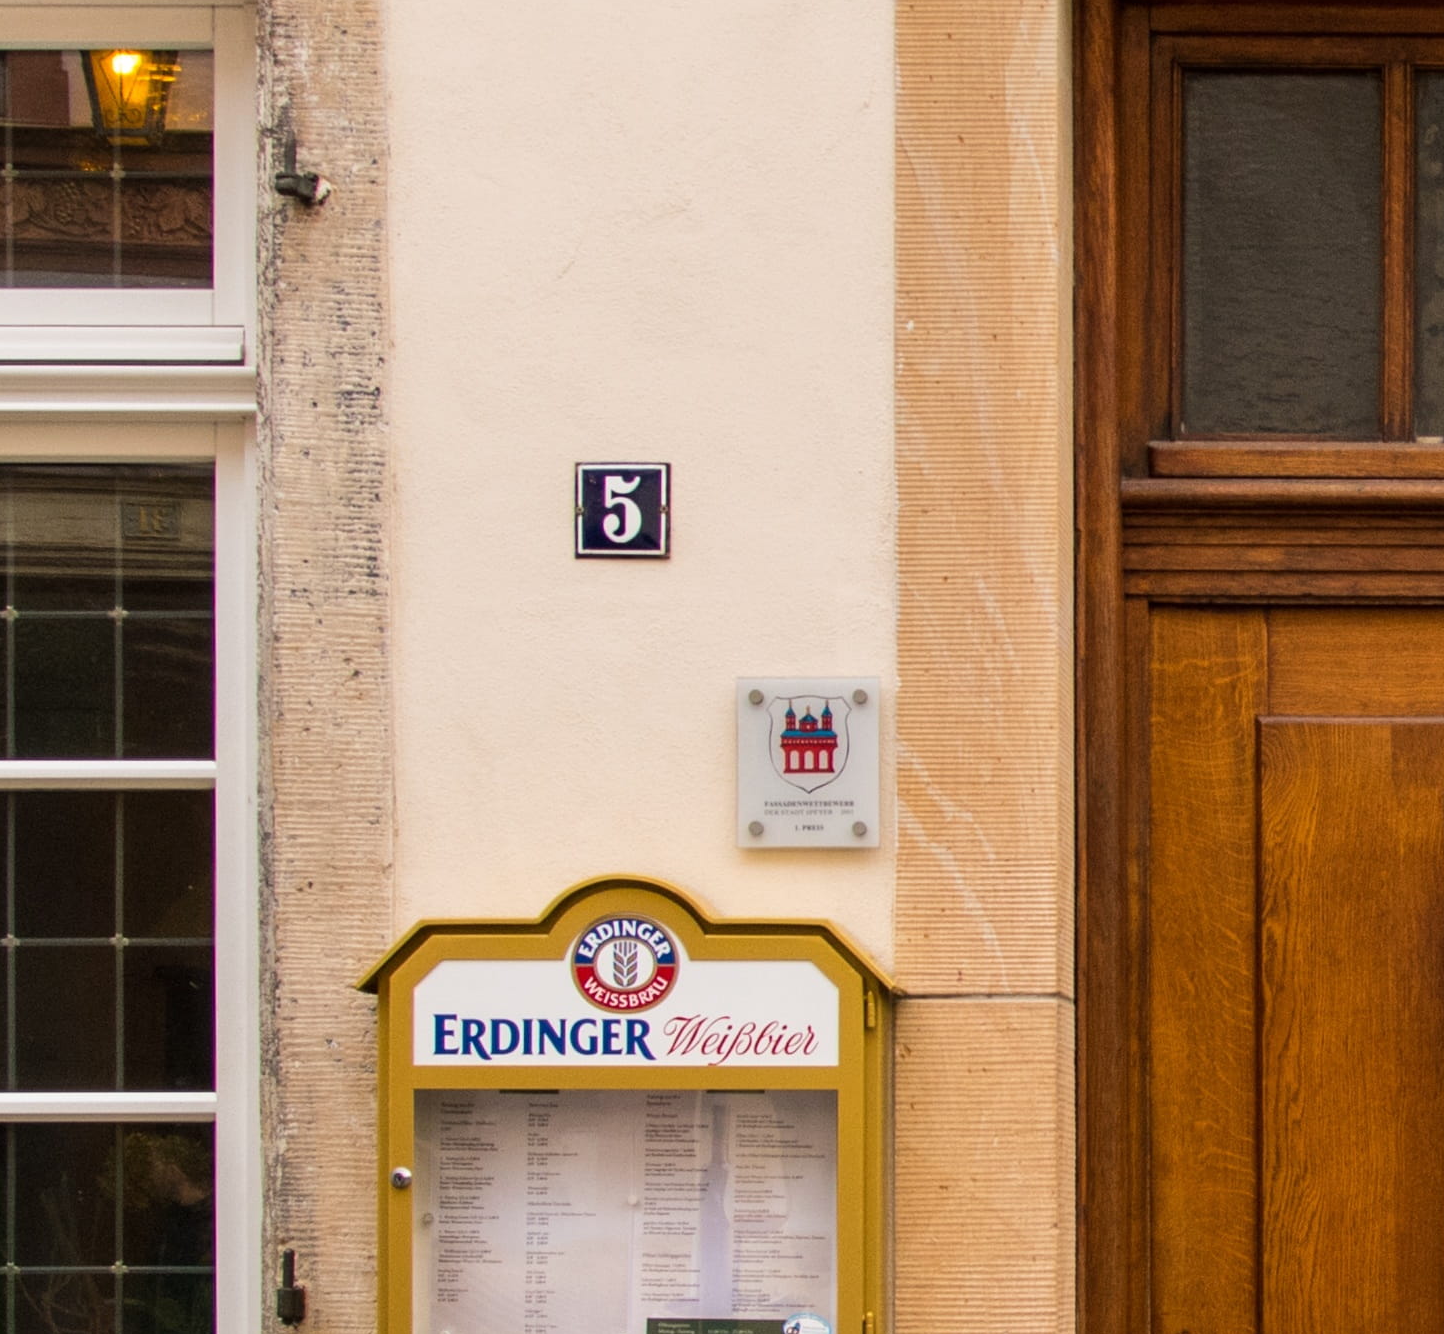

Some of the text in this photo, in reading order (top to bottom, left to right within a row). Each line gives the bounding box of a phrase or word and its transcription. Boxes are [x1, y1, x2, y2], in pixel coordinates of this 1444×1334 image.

[603, 475, 643, 544] 5
[578, 920, 671, 958] ERDINGER
[433, 1014, 819, 1066] ERDINGER Weißbier
